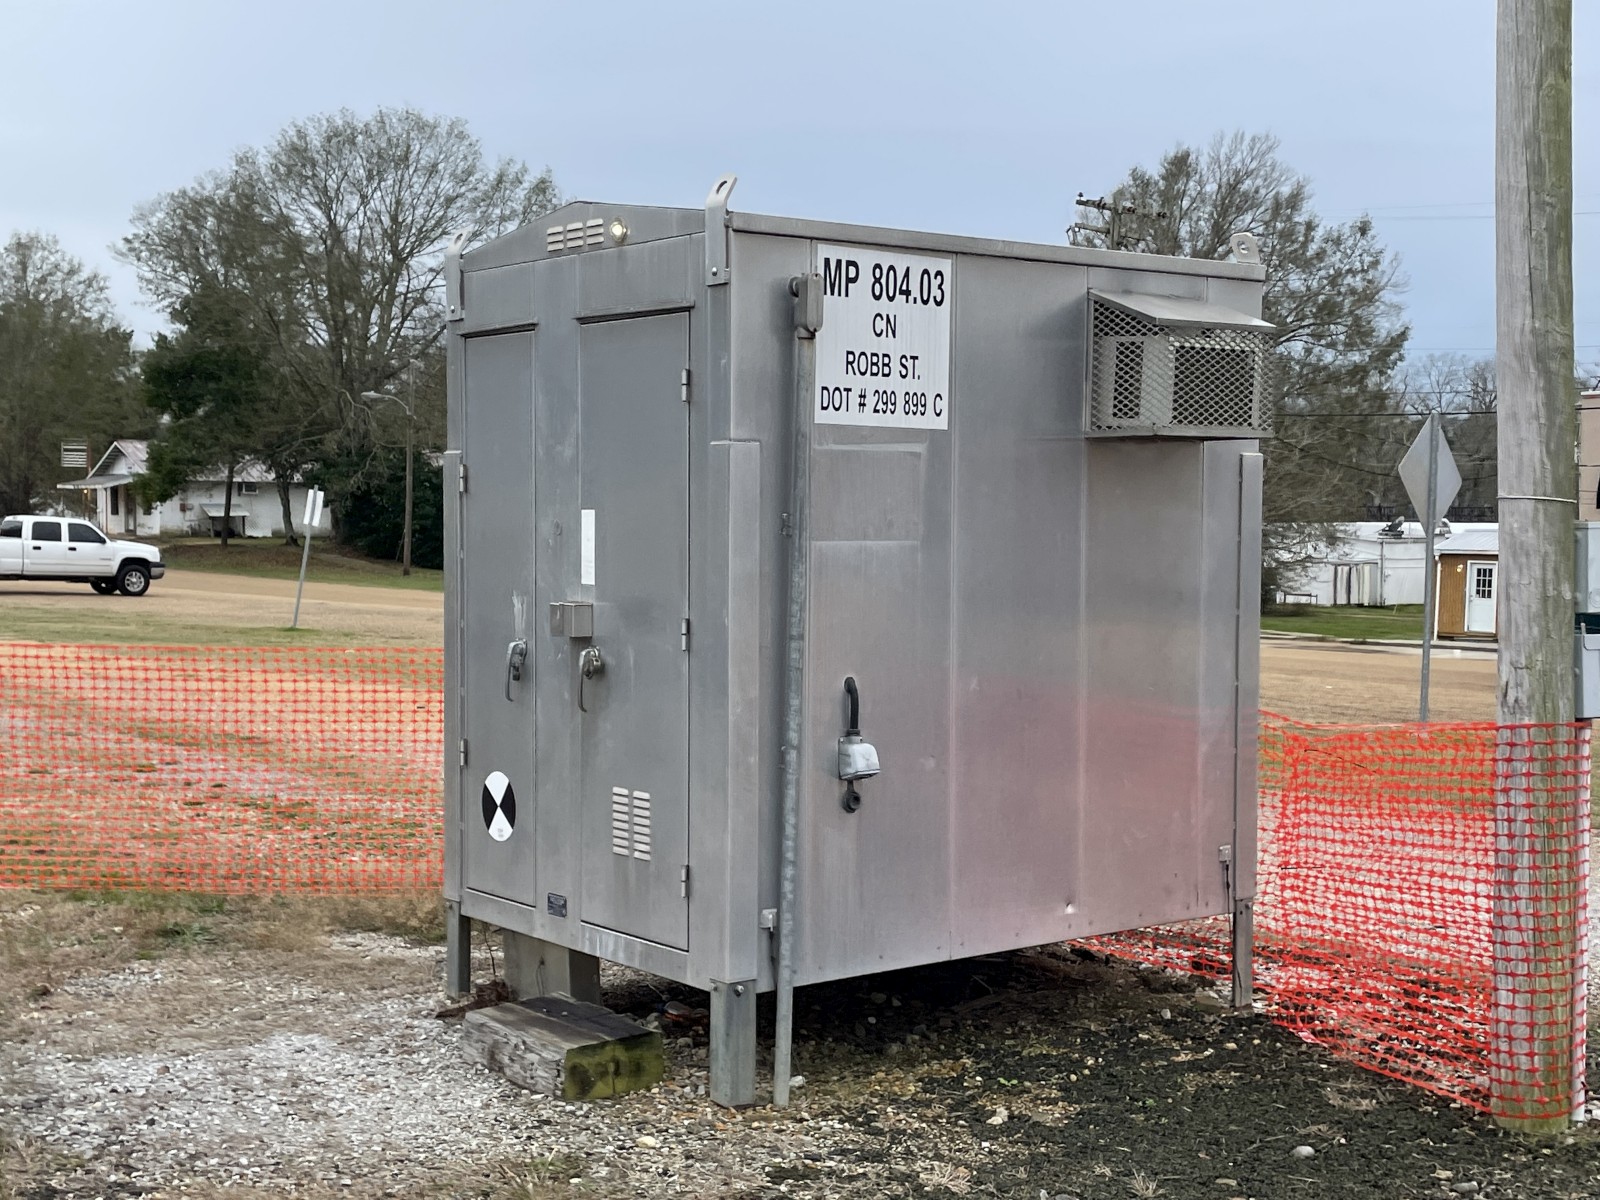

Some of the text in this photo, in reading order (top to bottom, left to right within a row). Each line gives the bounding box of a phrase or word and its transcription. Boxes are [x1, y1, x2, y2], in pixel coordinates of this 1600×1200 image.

[823, 257, 945, 307] MP 804.03
[872, 312, 897, 339] CN
[845, 350, 921, 380] ROBB ST.
[820, 386, 943, 417] DOT # 299 899 C
